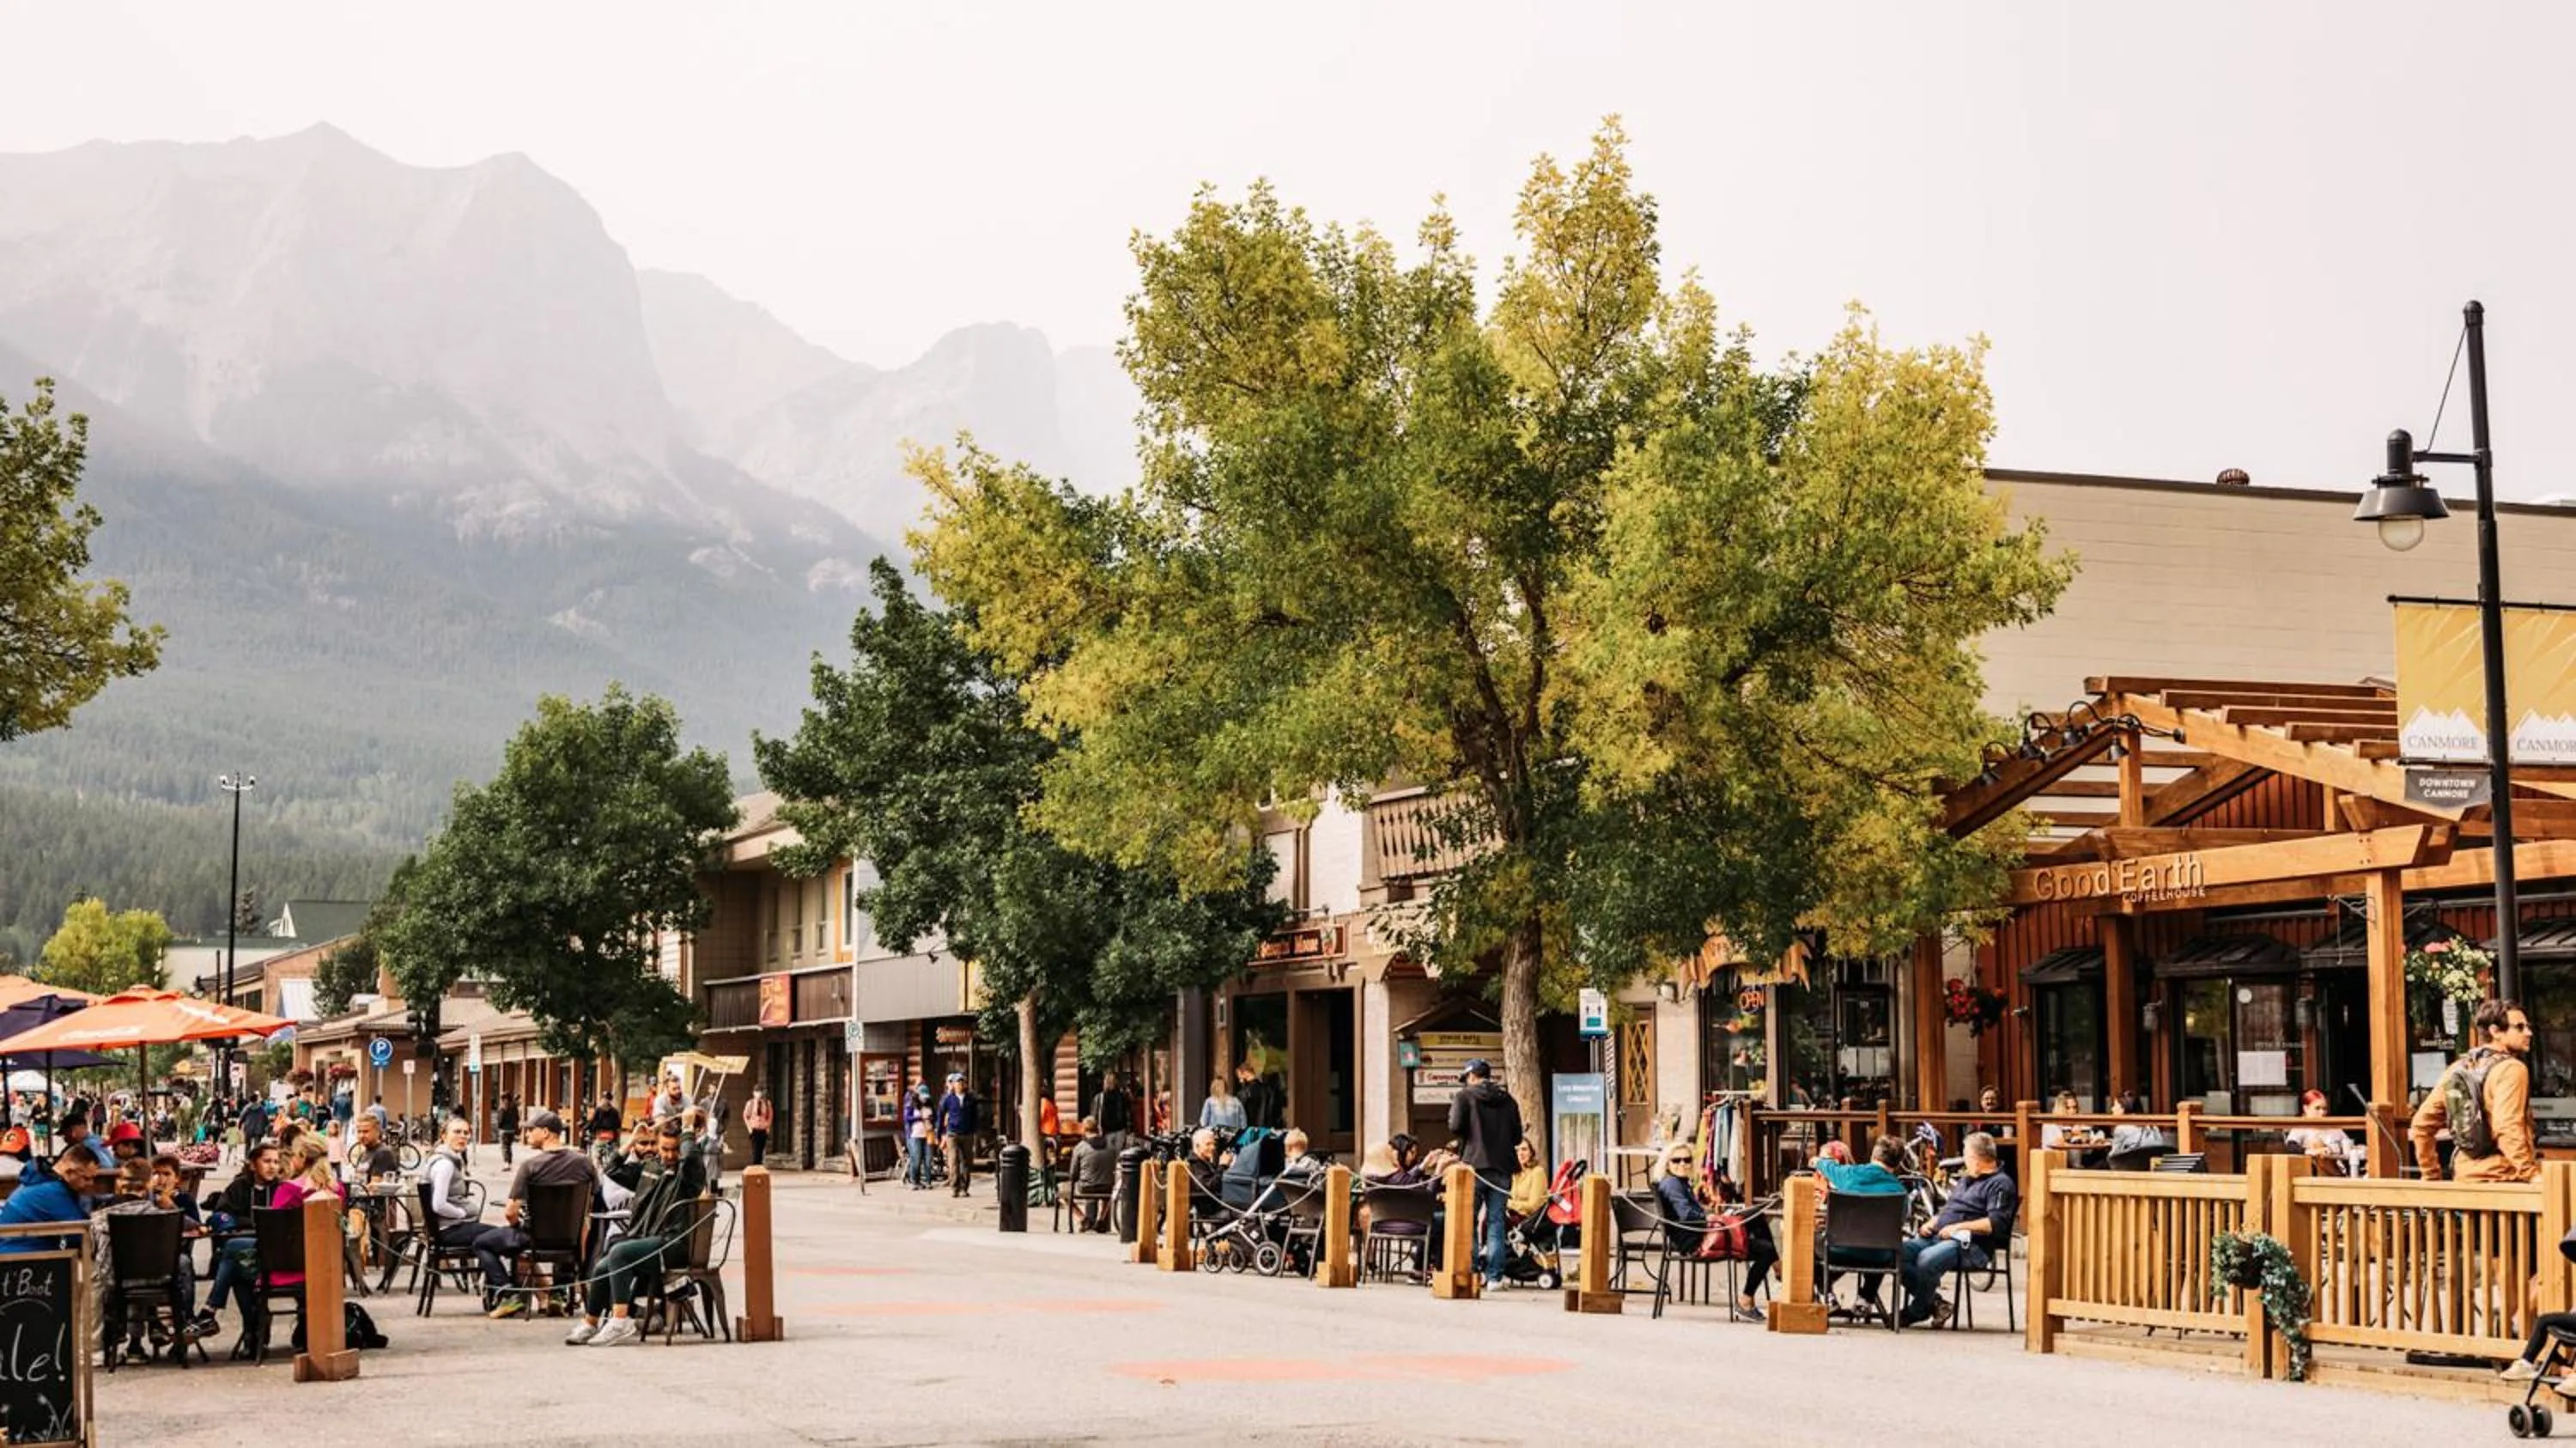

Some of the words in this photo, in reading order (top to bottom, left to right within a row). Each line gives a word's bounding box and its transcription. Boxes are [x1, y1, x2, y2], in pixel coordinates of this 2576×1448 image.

[2408, 734, 2478, 750] CANMORE
[2517, 739, 2576, 753] CANMOR
[2419, 777, 2476, 788] DOWNTOWN
[2422, 788, 2470, 800] CANMORE
[2033, 861, 2111, 900] Good
[2118, 854, 2204, 892] Earth
[2122, 886, 2206, 903] COFFEEHOUSE
[1740, 989, 1765, 1010] OPEN
[376, 1041, 386, 1054] P
[16, 1267, 54, 1297] Boot
[0, 1322, 65, 1382] le!
